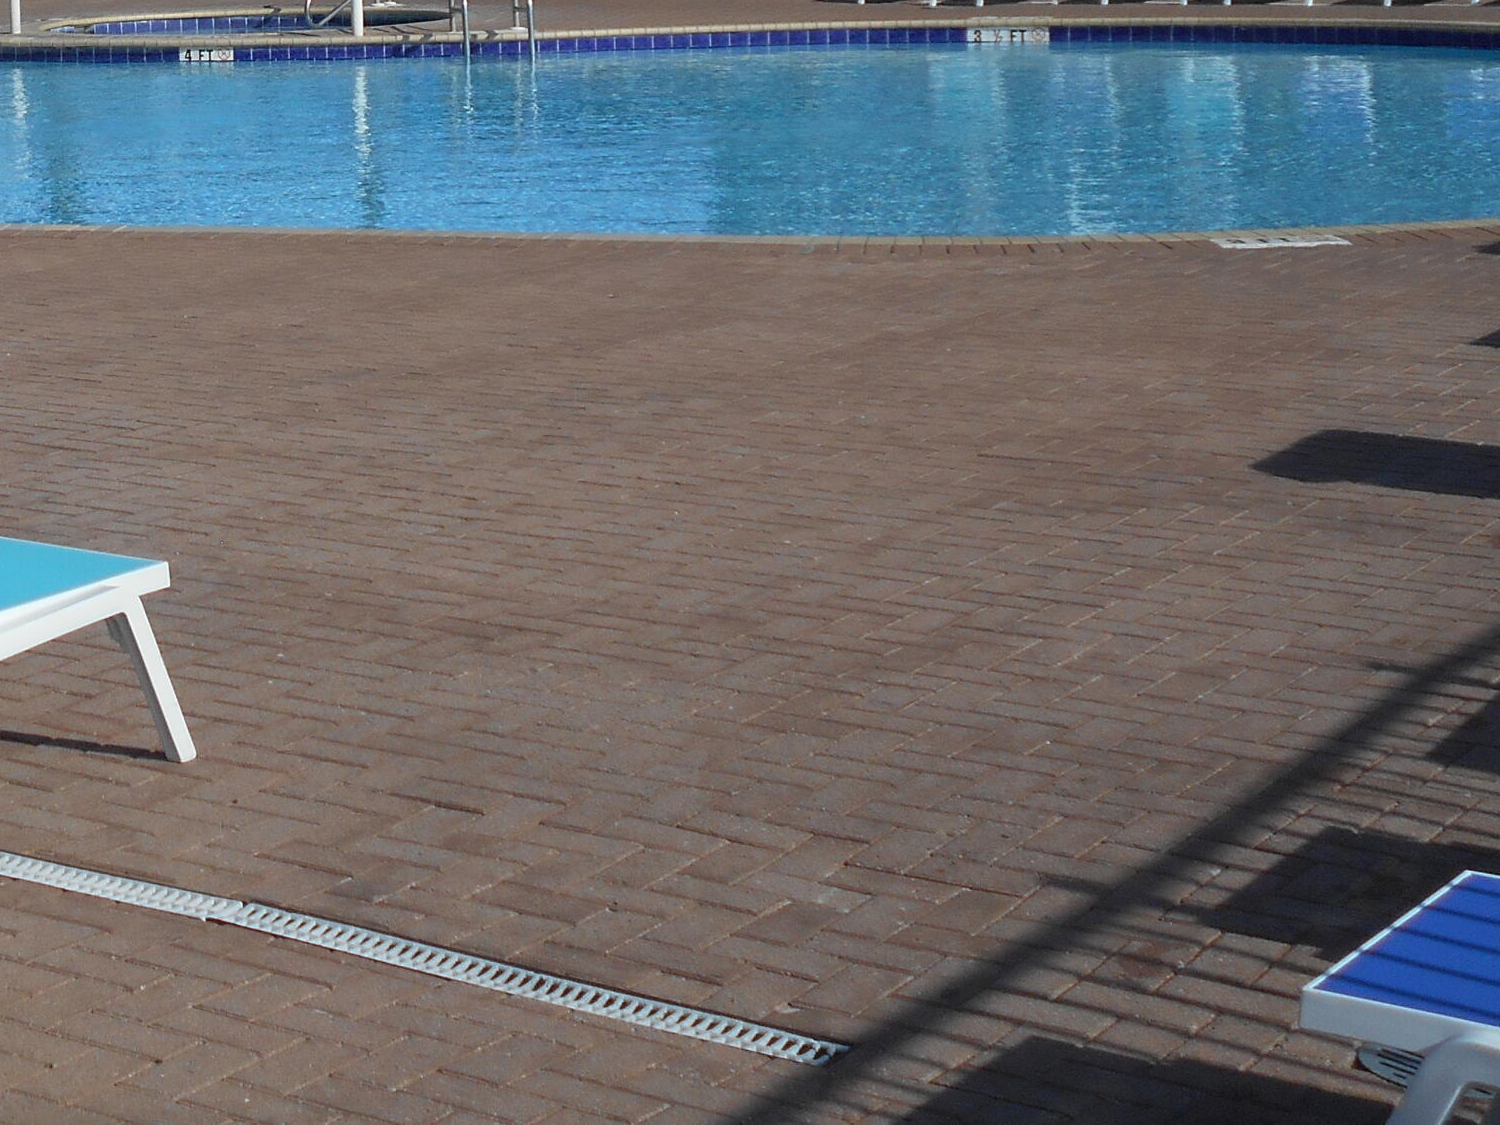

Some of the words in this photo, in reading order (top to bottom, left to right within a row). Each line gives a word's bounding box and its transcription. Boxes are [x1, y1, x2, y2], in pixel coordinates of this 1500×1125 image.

[974, 29, 982, 43] 3
[1010, 29, 1026, 43] FT
[184, 49, 192, 62] 4
[198, 49, 213, 62] FT
